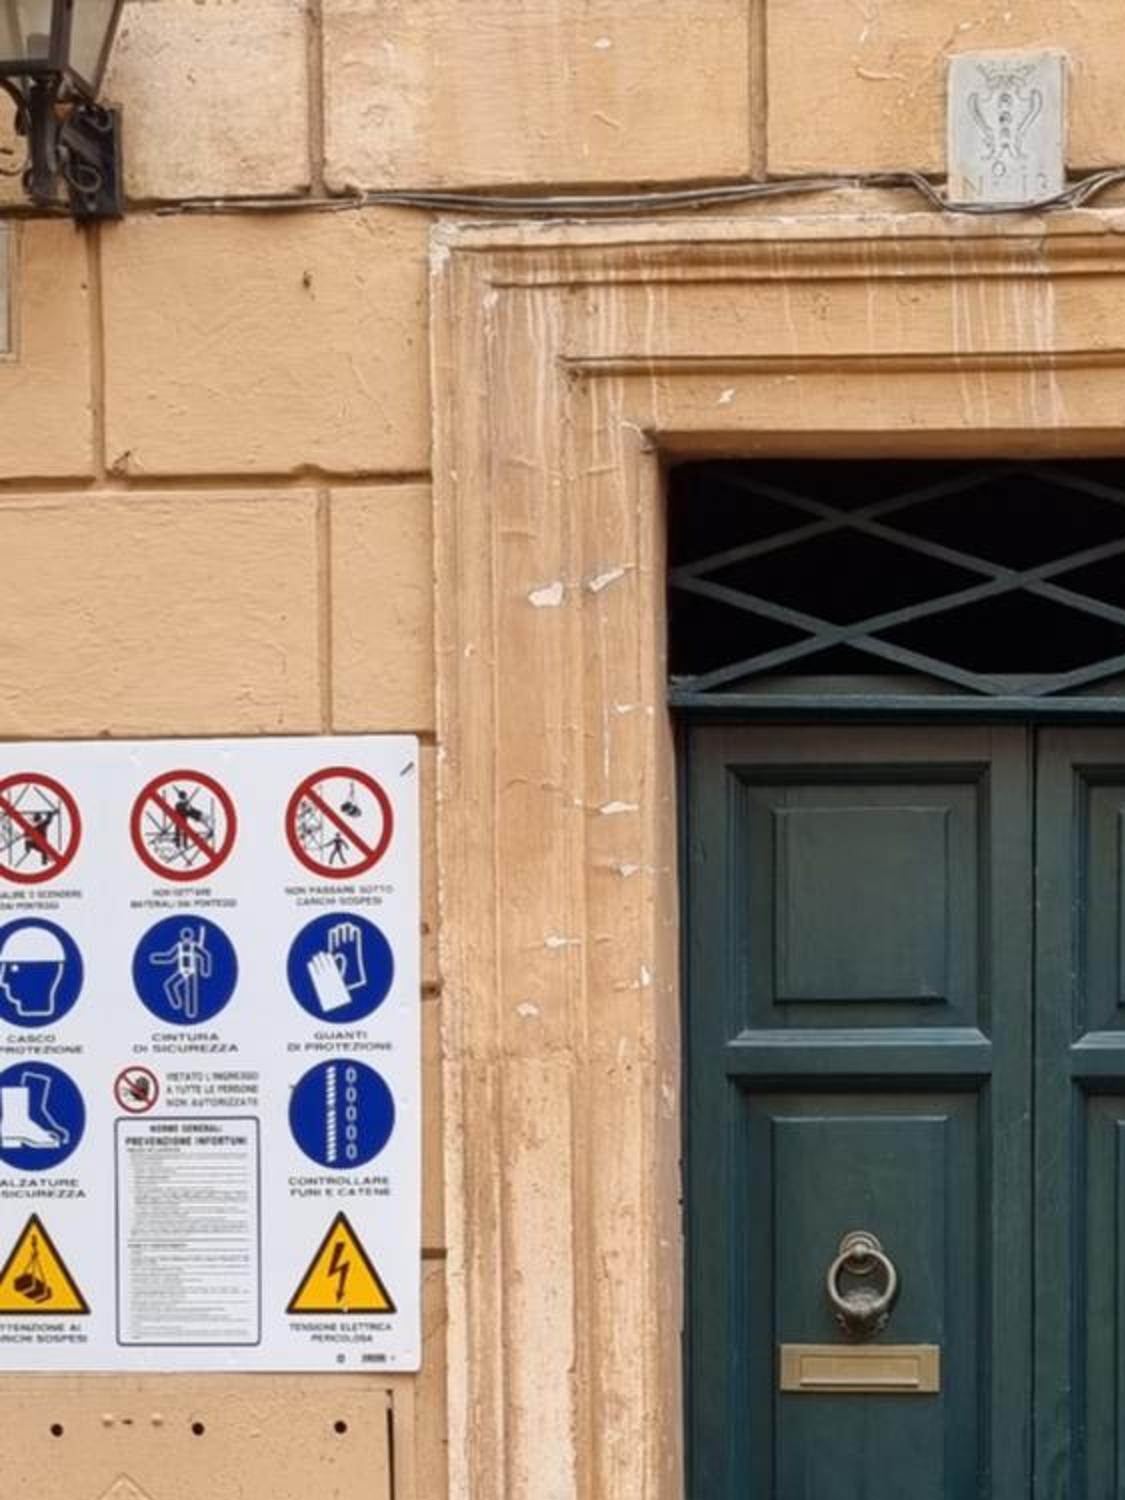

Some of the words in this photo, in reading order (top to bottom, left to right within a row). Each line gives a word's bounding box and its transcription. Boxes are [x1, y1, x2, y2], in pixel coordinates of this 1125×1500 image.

[284, 885, 306, 895] NON
[309, 884, 355, 895] PASSARE
[360, 883, 394, 894] SOTTO
[296, 896, 336, 906] CARICHI
[339, 895, 383, 906] SOSPESI
[7, 1034, 56, 1043] CASCO
[151, 1033, 219, 1043] CINTURA
[314, 1031, 368, 1040] GUANTI
[133, 1044, 149, 1054] DI
[152, 1043, 239, 1054] SICUREZZA
[287, 1042, 301, 1052] DI
[304, 1041, 393, 1052] PROTEZIONE
[166, 1071, 203, 1081] VIETATO
[166, 1085, 173, 1094] A
[175, 1085, 201, 1094] TUTTE
[204, 1085, 215, 1094] LE
[217, 1084, 258, 1093] PERSONE
[166, 1098, 187, 1107] NON
[190, 1096, 258, 1107] AUTORIZZATE
[125, 1136, 192, 1146] PREVENZIONE
[0, 1178, 79, 1188] ALZATURE
[288, 1175, 390, 1186] CONTROLLARE
[290, 1187, 321, 1197] FUNI
[325, 1187, 332, 1197] E
[338, 1187, 390, 1197] CATENE
[289, 1321, 337, 1332] TENSIONE
[339, 1321, 392, 1332] ELETTRICA
[311, 1333, 373, 1343] PERICOLOSA
